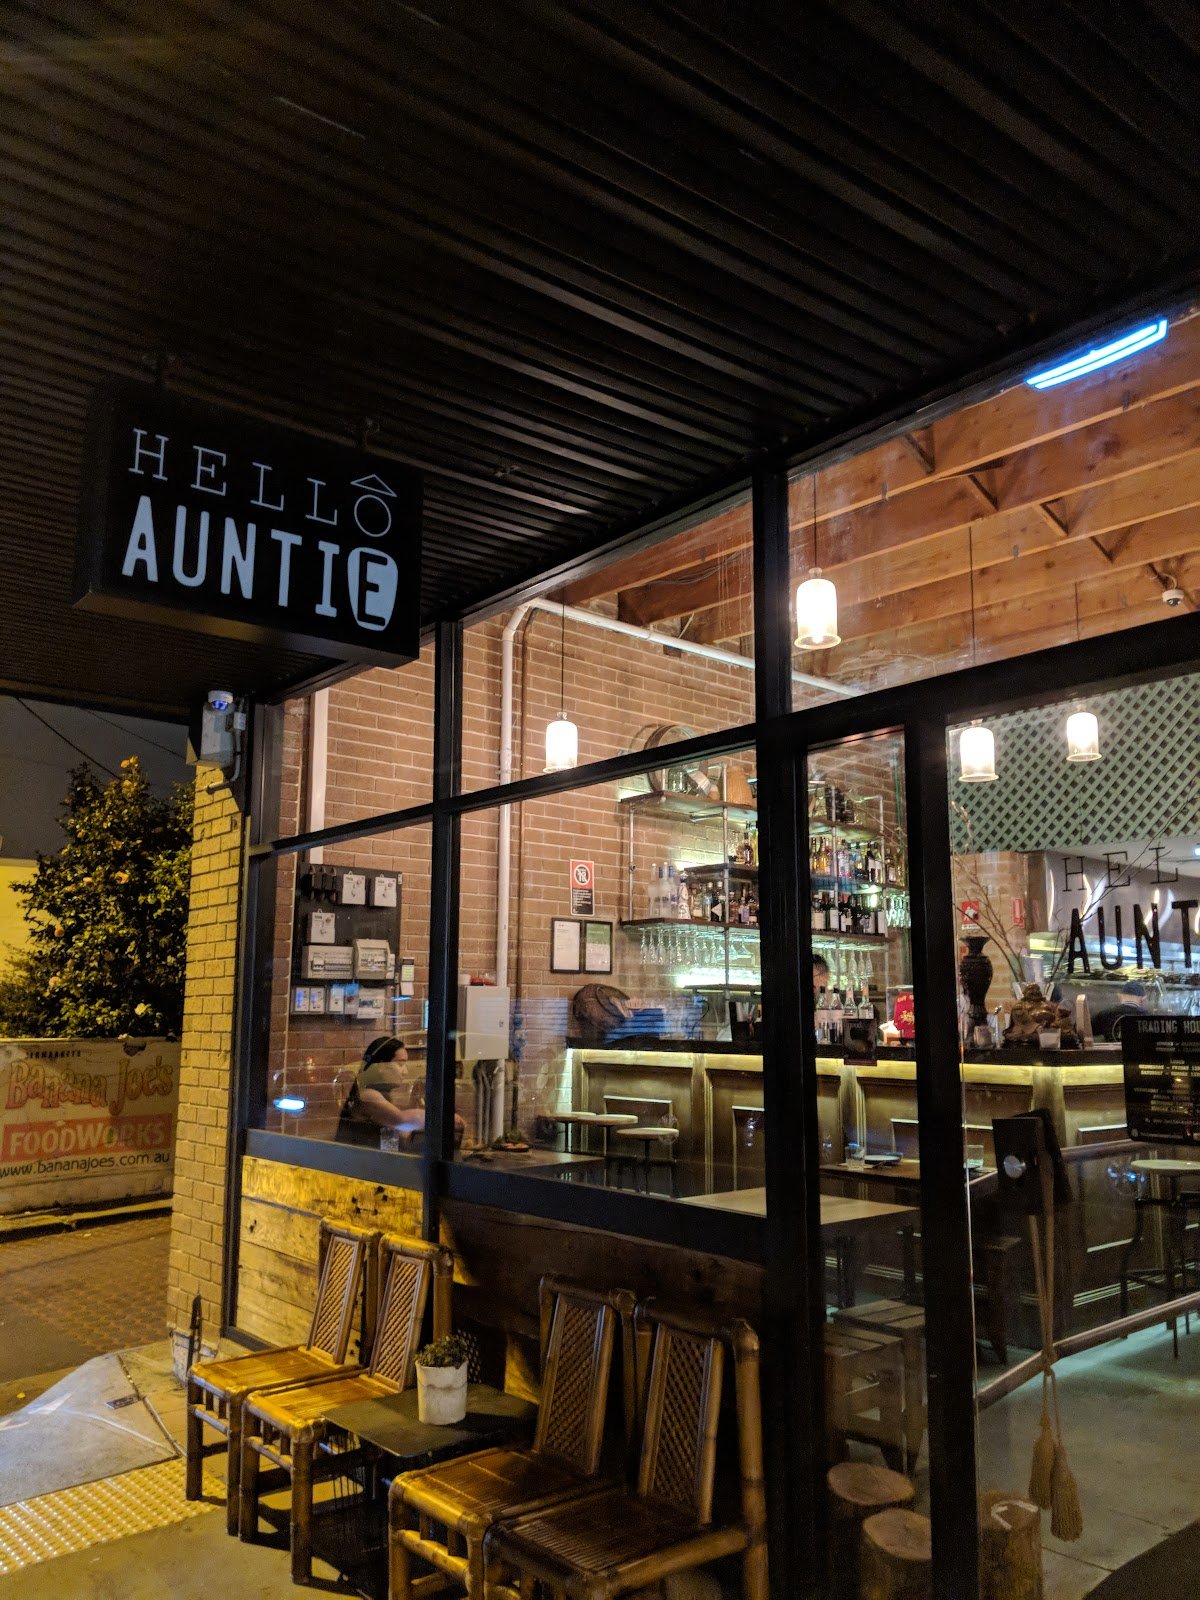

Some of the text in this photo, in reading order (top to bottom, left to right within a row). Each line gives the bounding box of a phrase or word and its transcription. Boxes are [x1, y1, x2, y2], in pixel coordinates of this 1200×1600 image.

[128, 428, 398, 538] HELLÔ
[121, 494, 398, 632] AUNTIE
[1067, 899, 1198, 974] AUNT
[1136, 1019, 1178, 1034] TRADING
[0, 1152, 171, 1178] www.bananajoes.com.au
[9, 1121, 166, 1156] FOODWORKS
